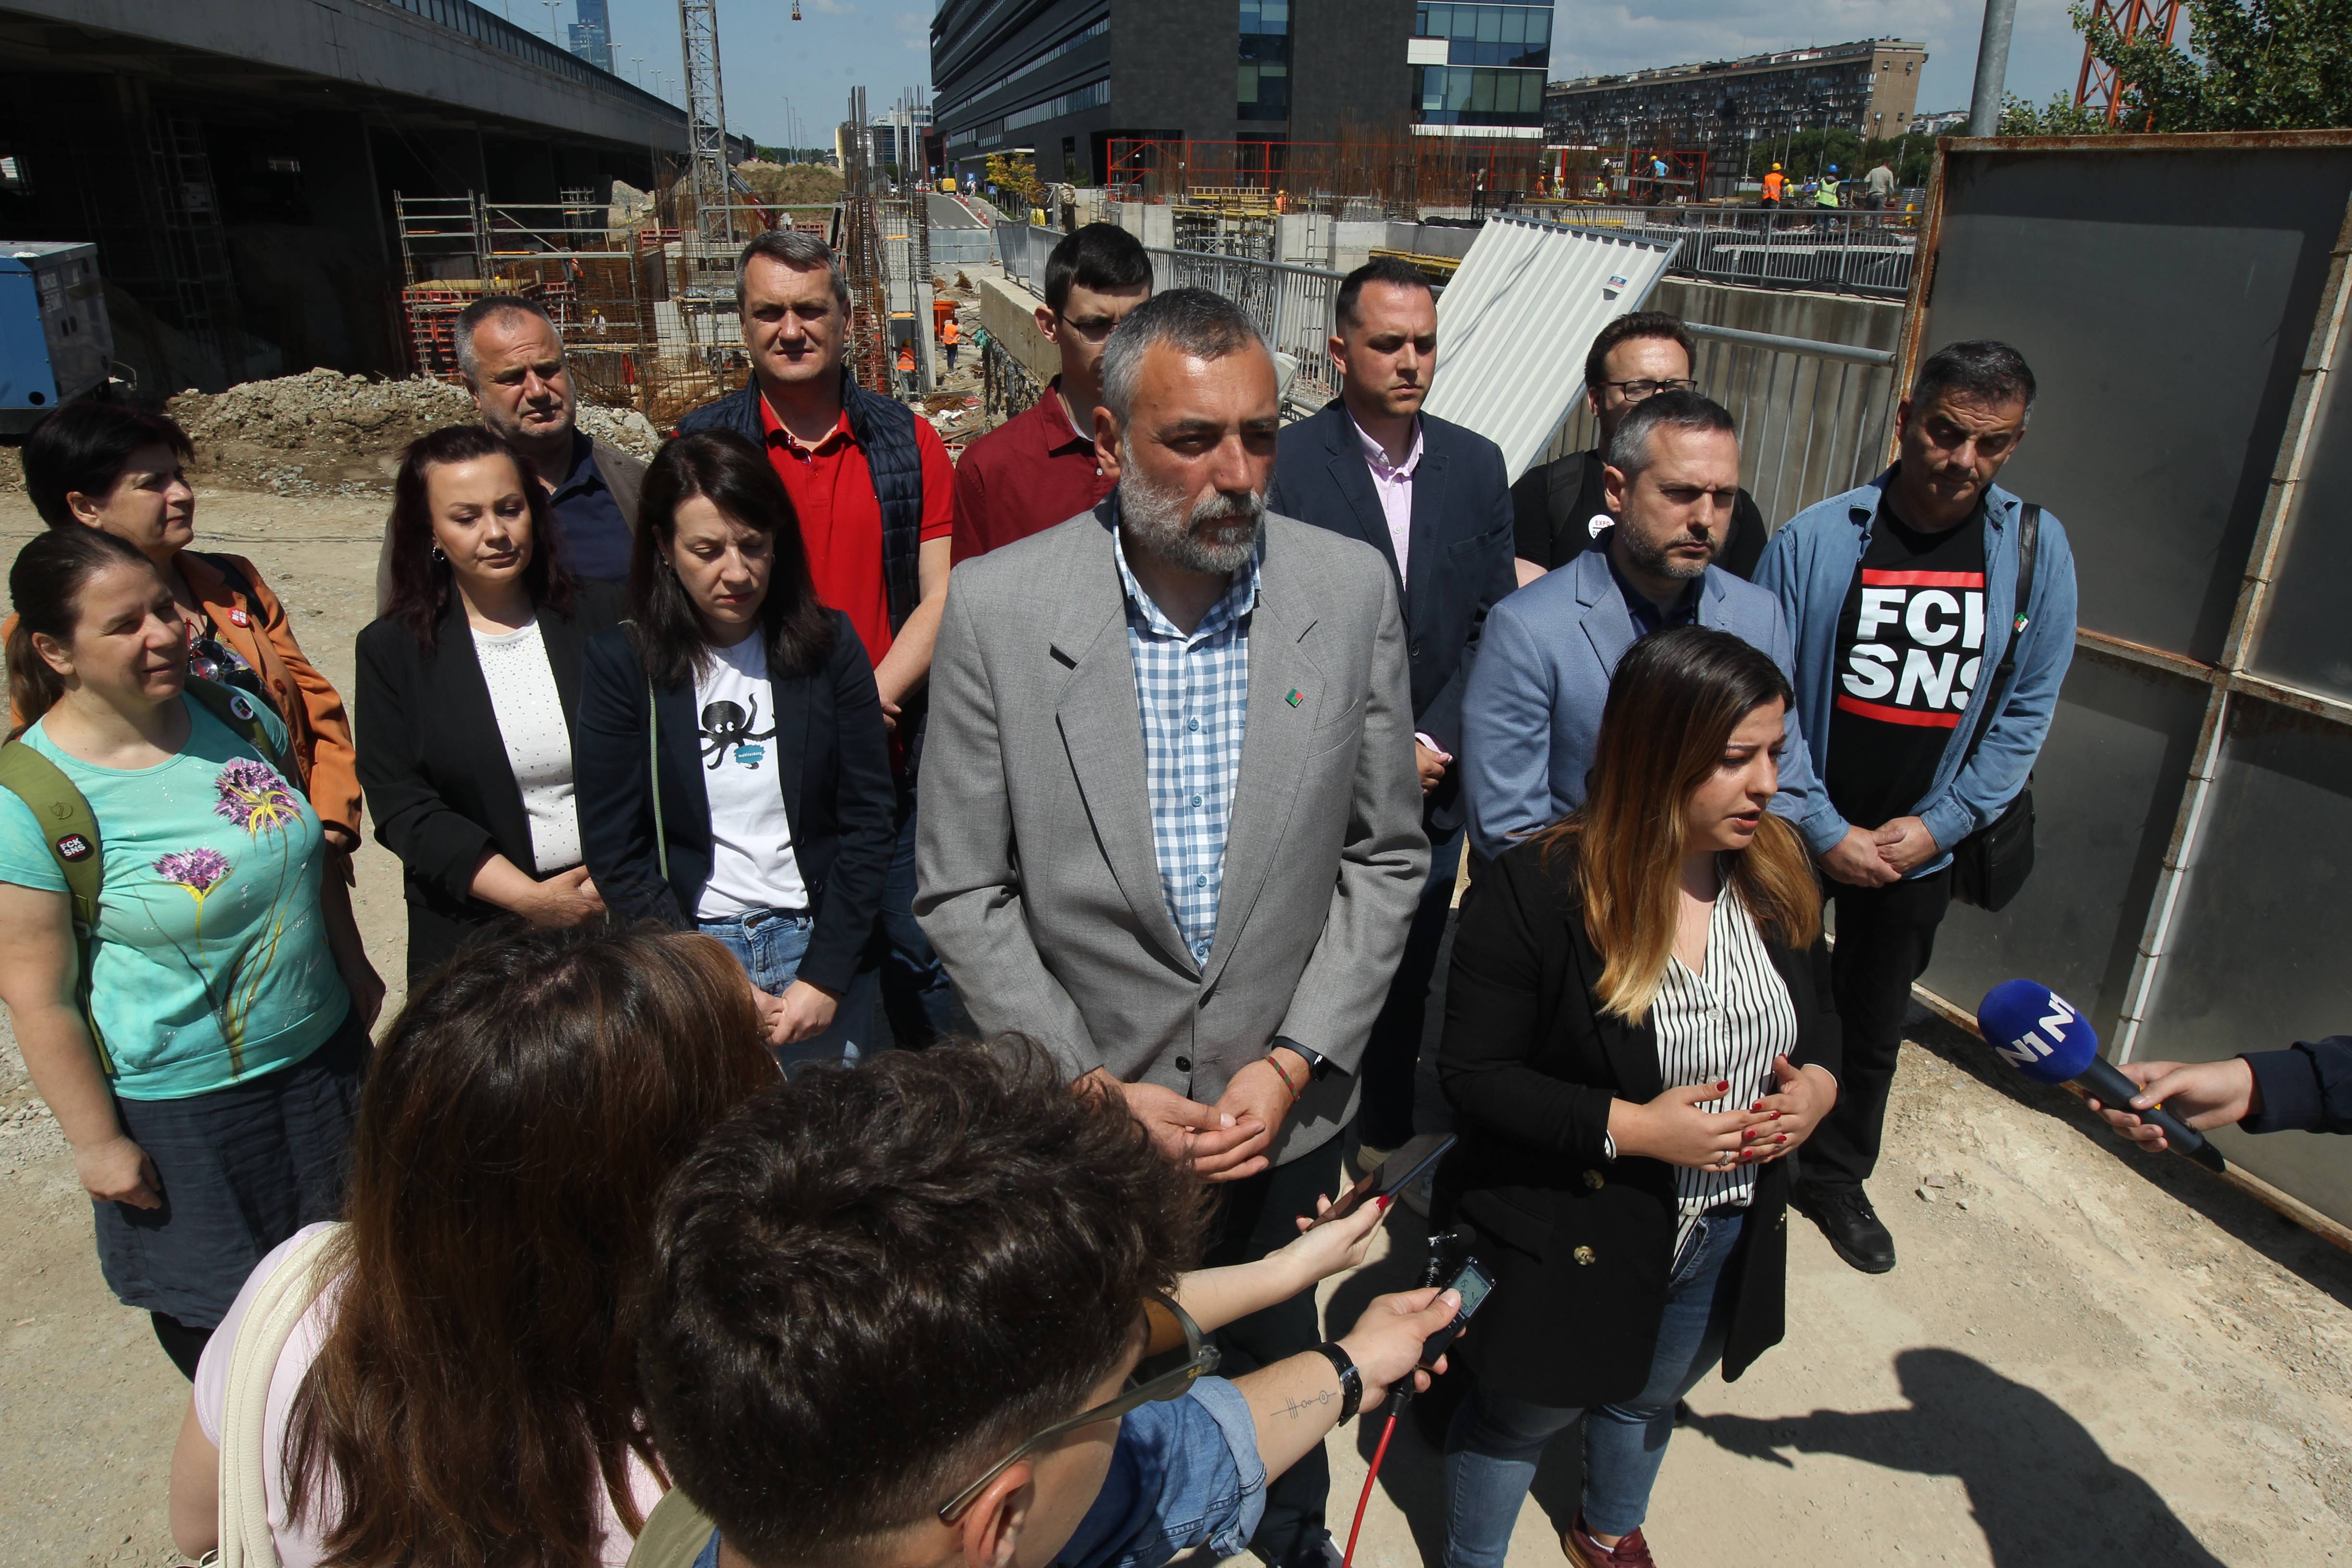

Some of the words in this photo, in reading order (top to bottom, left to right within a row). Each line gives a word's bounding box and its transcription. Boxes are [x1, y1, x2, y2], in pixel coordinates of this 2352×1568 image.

[60, 837, 82, 850] FCK
[63, 844, 86, 856] SNS
[1995, 1031, 2054, 1068] N1
